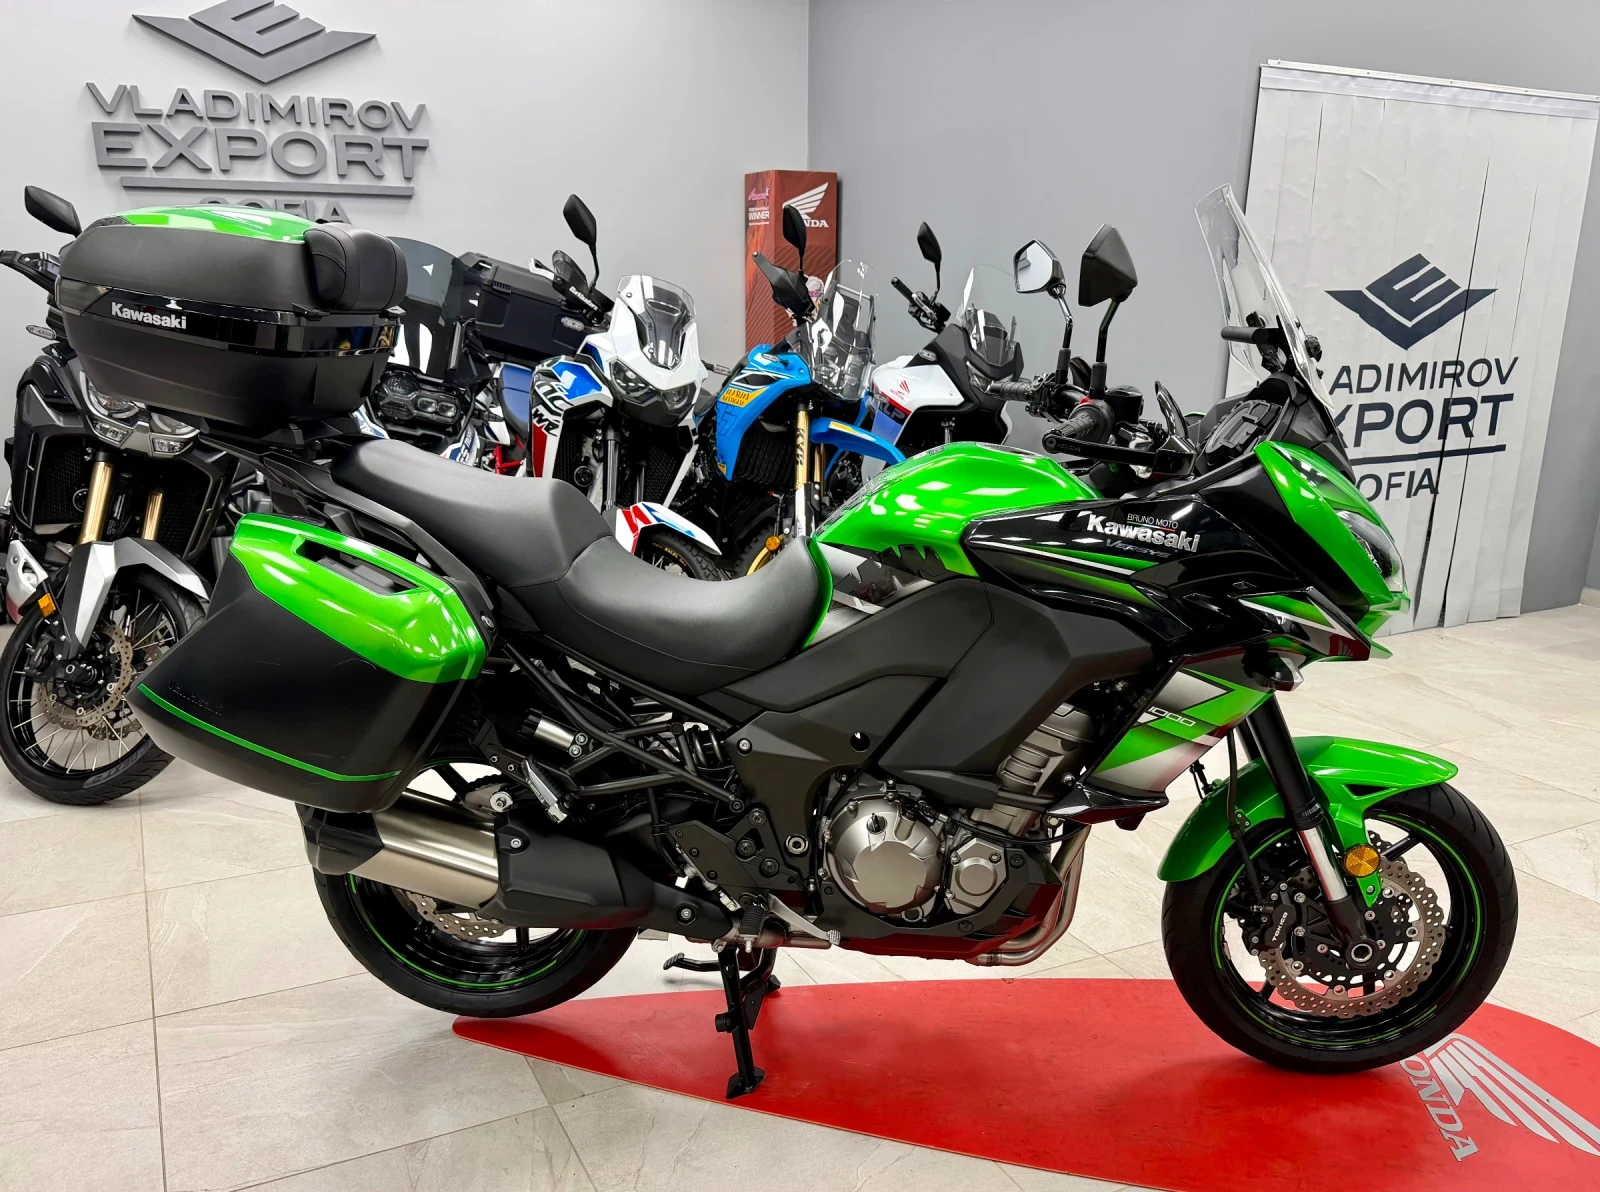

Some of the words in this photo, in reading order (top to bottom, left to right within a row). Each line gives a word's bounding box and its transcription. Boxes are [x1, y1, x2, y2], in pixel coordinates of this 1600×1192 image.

[86, 82, 426, 130] VLADIMIROV
[92, 121, 429, 179] EXPORT
[111, 301, 187, 330] Kawasaki
[1328, 356, 1520, 396] ADIMIROV
[1356, 467, 1440, 502] OFIA
[1086, 513, 1200, 553] Kawasaki
[1127, 512, 1155, 526] BRUNO
[1155, 518, 1179, 530] MOTO
[1148, 705, 1197, 728] 1000
[1271, 911, 1289, 942] TOKICO
[1399, 1055, 1480, 1163] ONDA
